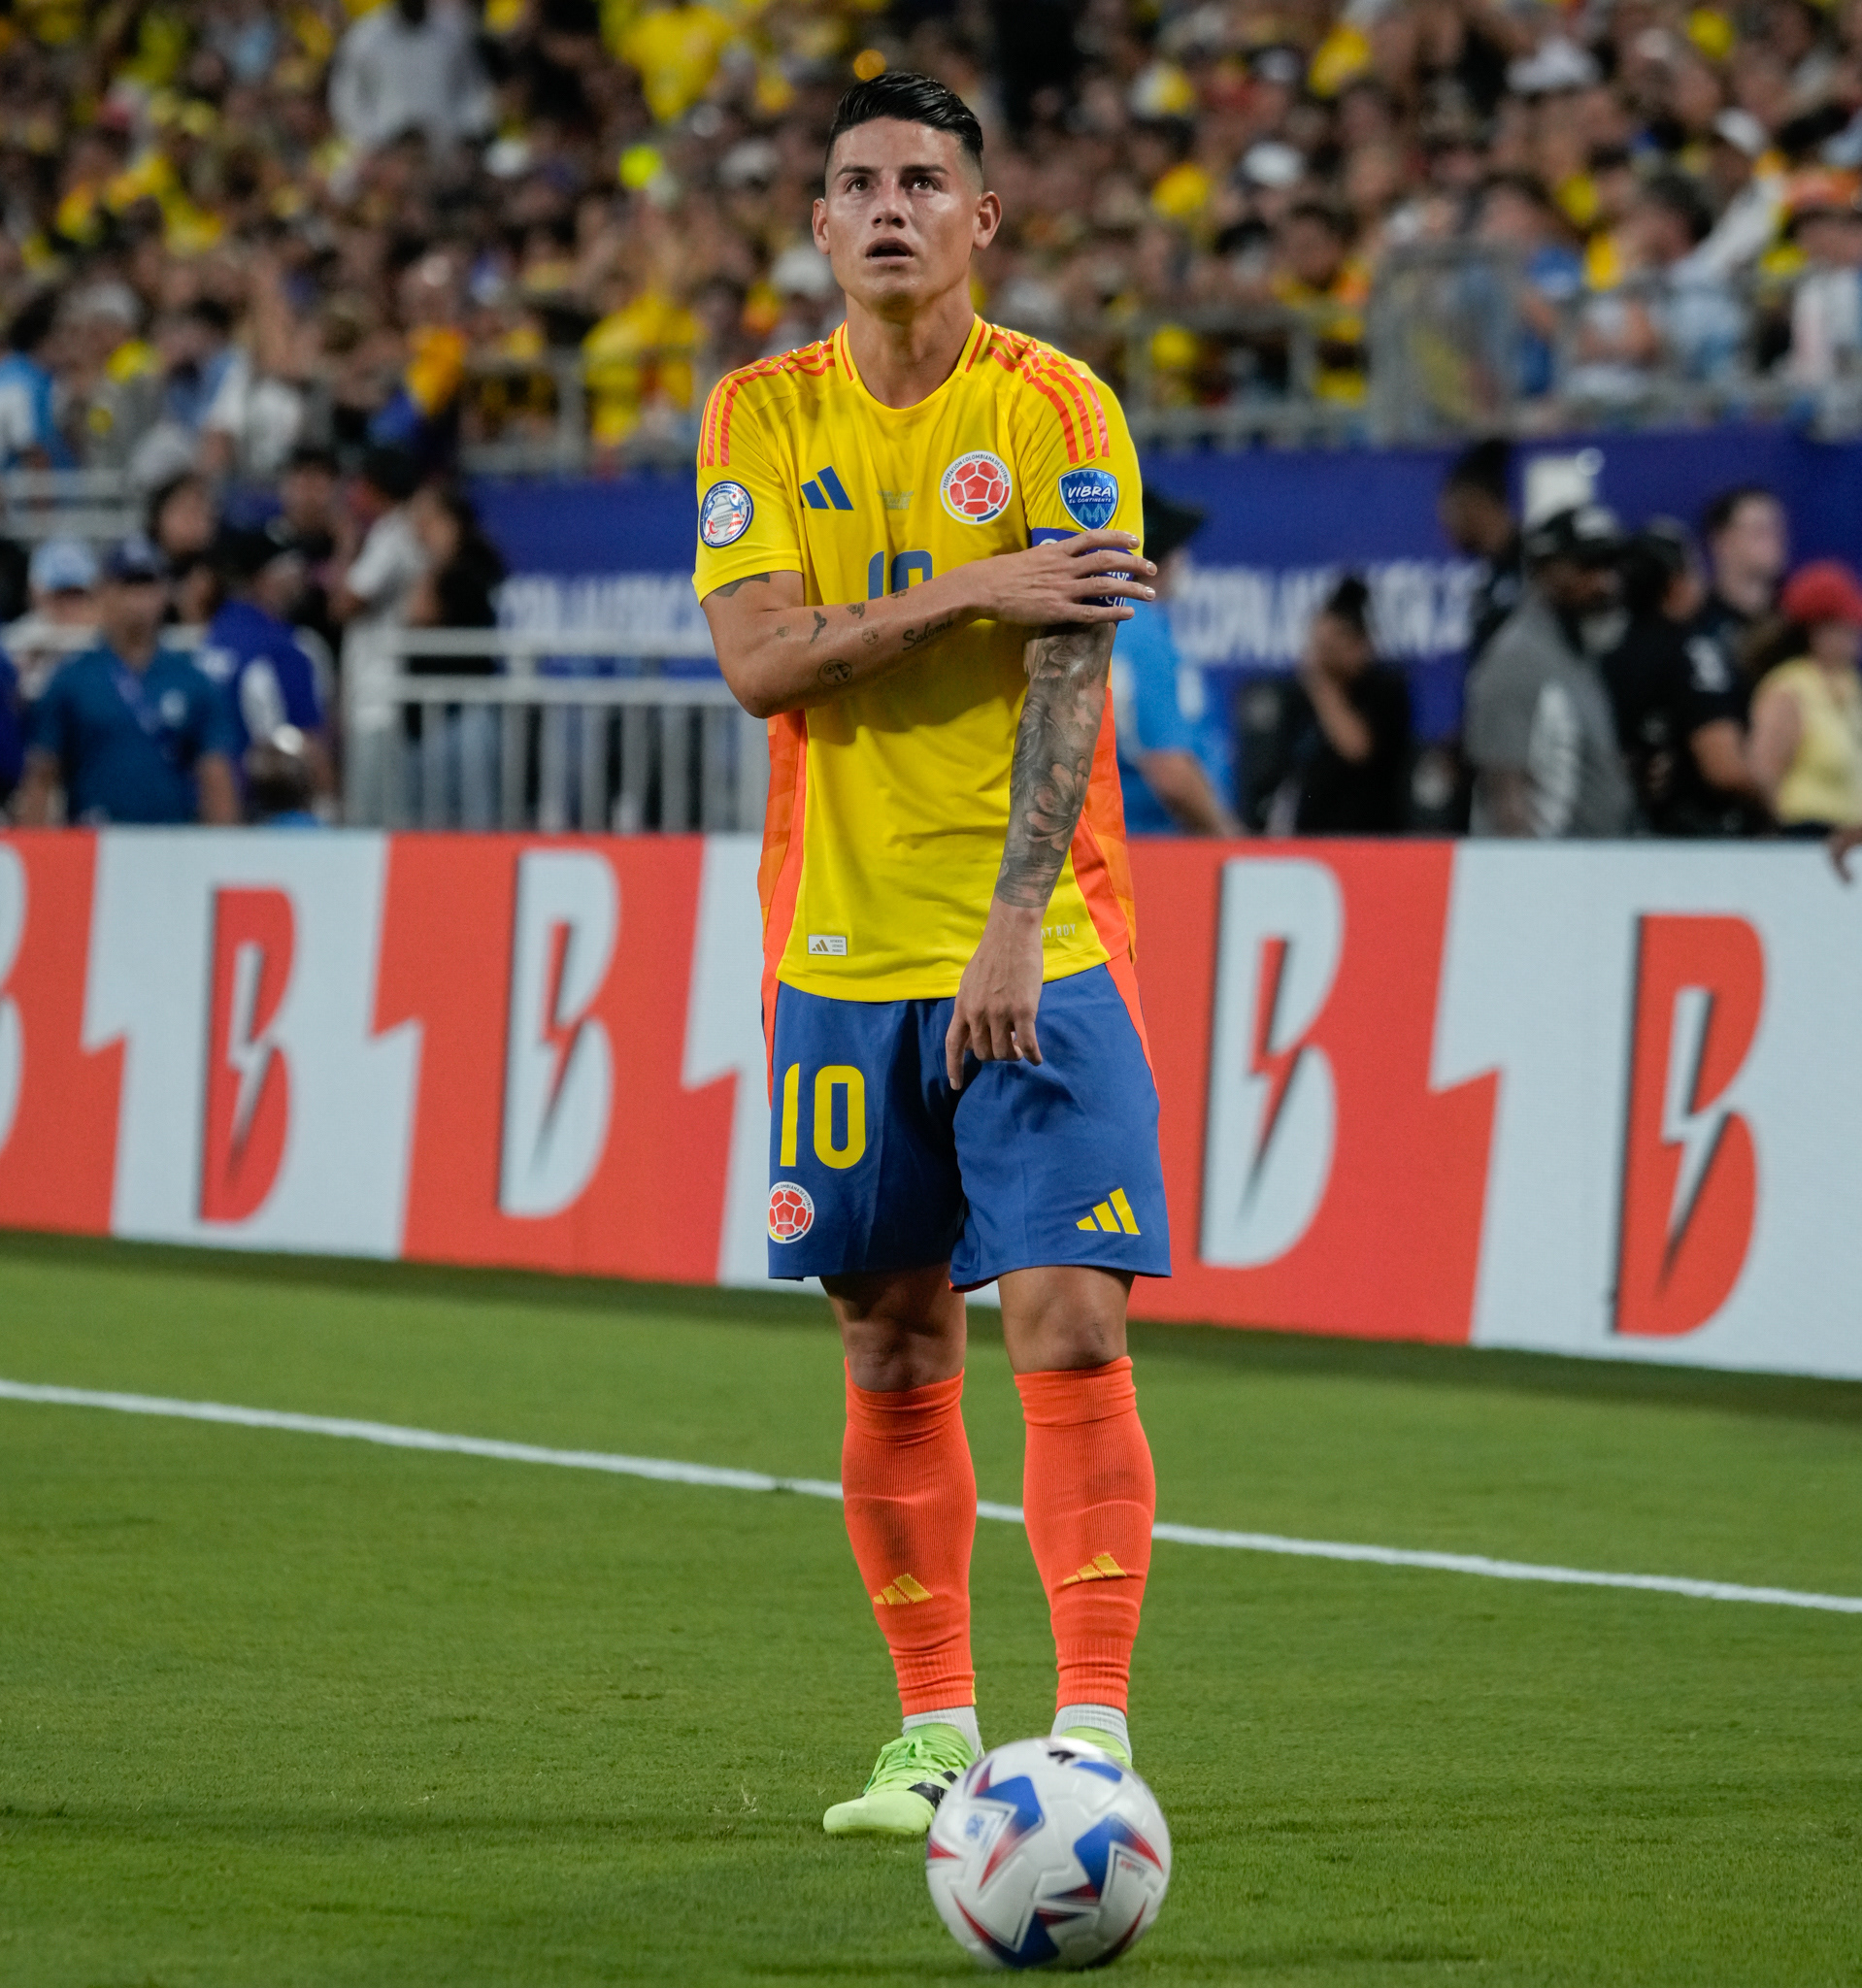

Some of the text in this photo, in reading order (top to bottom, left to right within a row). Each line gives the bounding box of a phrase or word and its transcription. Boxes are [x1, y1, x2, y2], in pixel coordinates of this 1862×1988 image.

[963, 453, 995, 464] COLOMBIANA
[1068, 485, 1112, 498] VIBRA
[780, 1062, 867, 1170] 10
